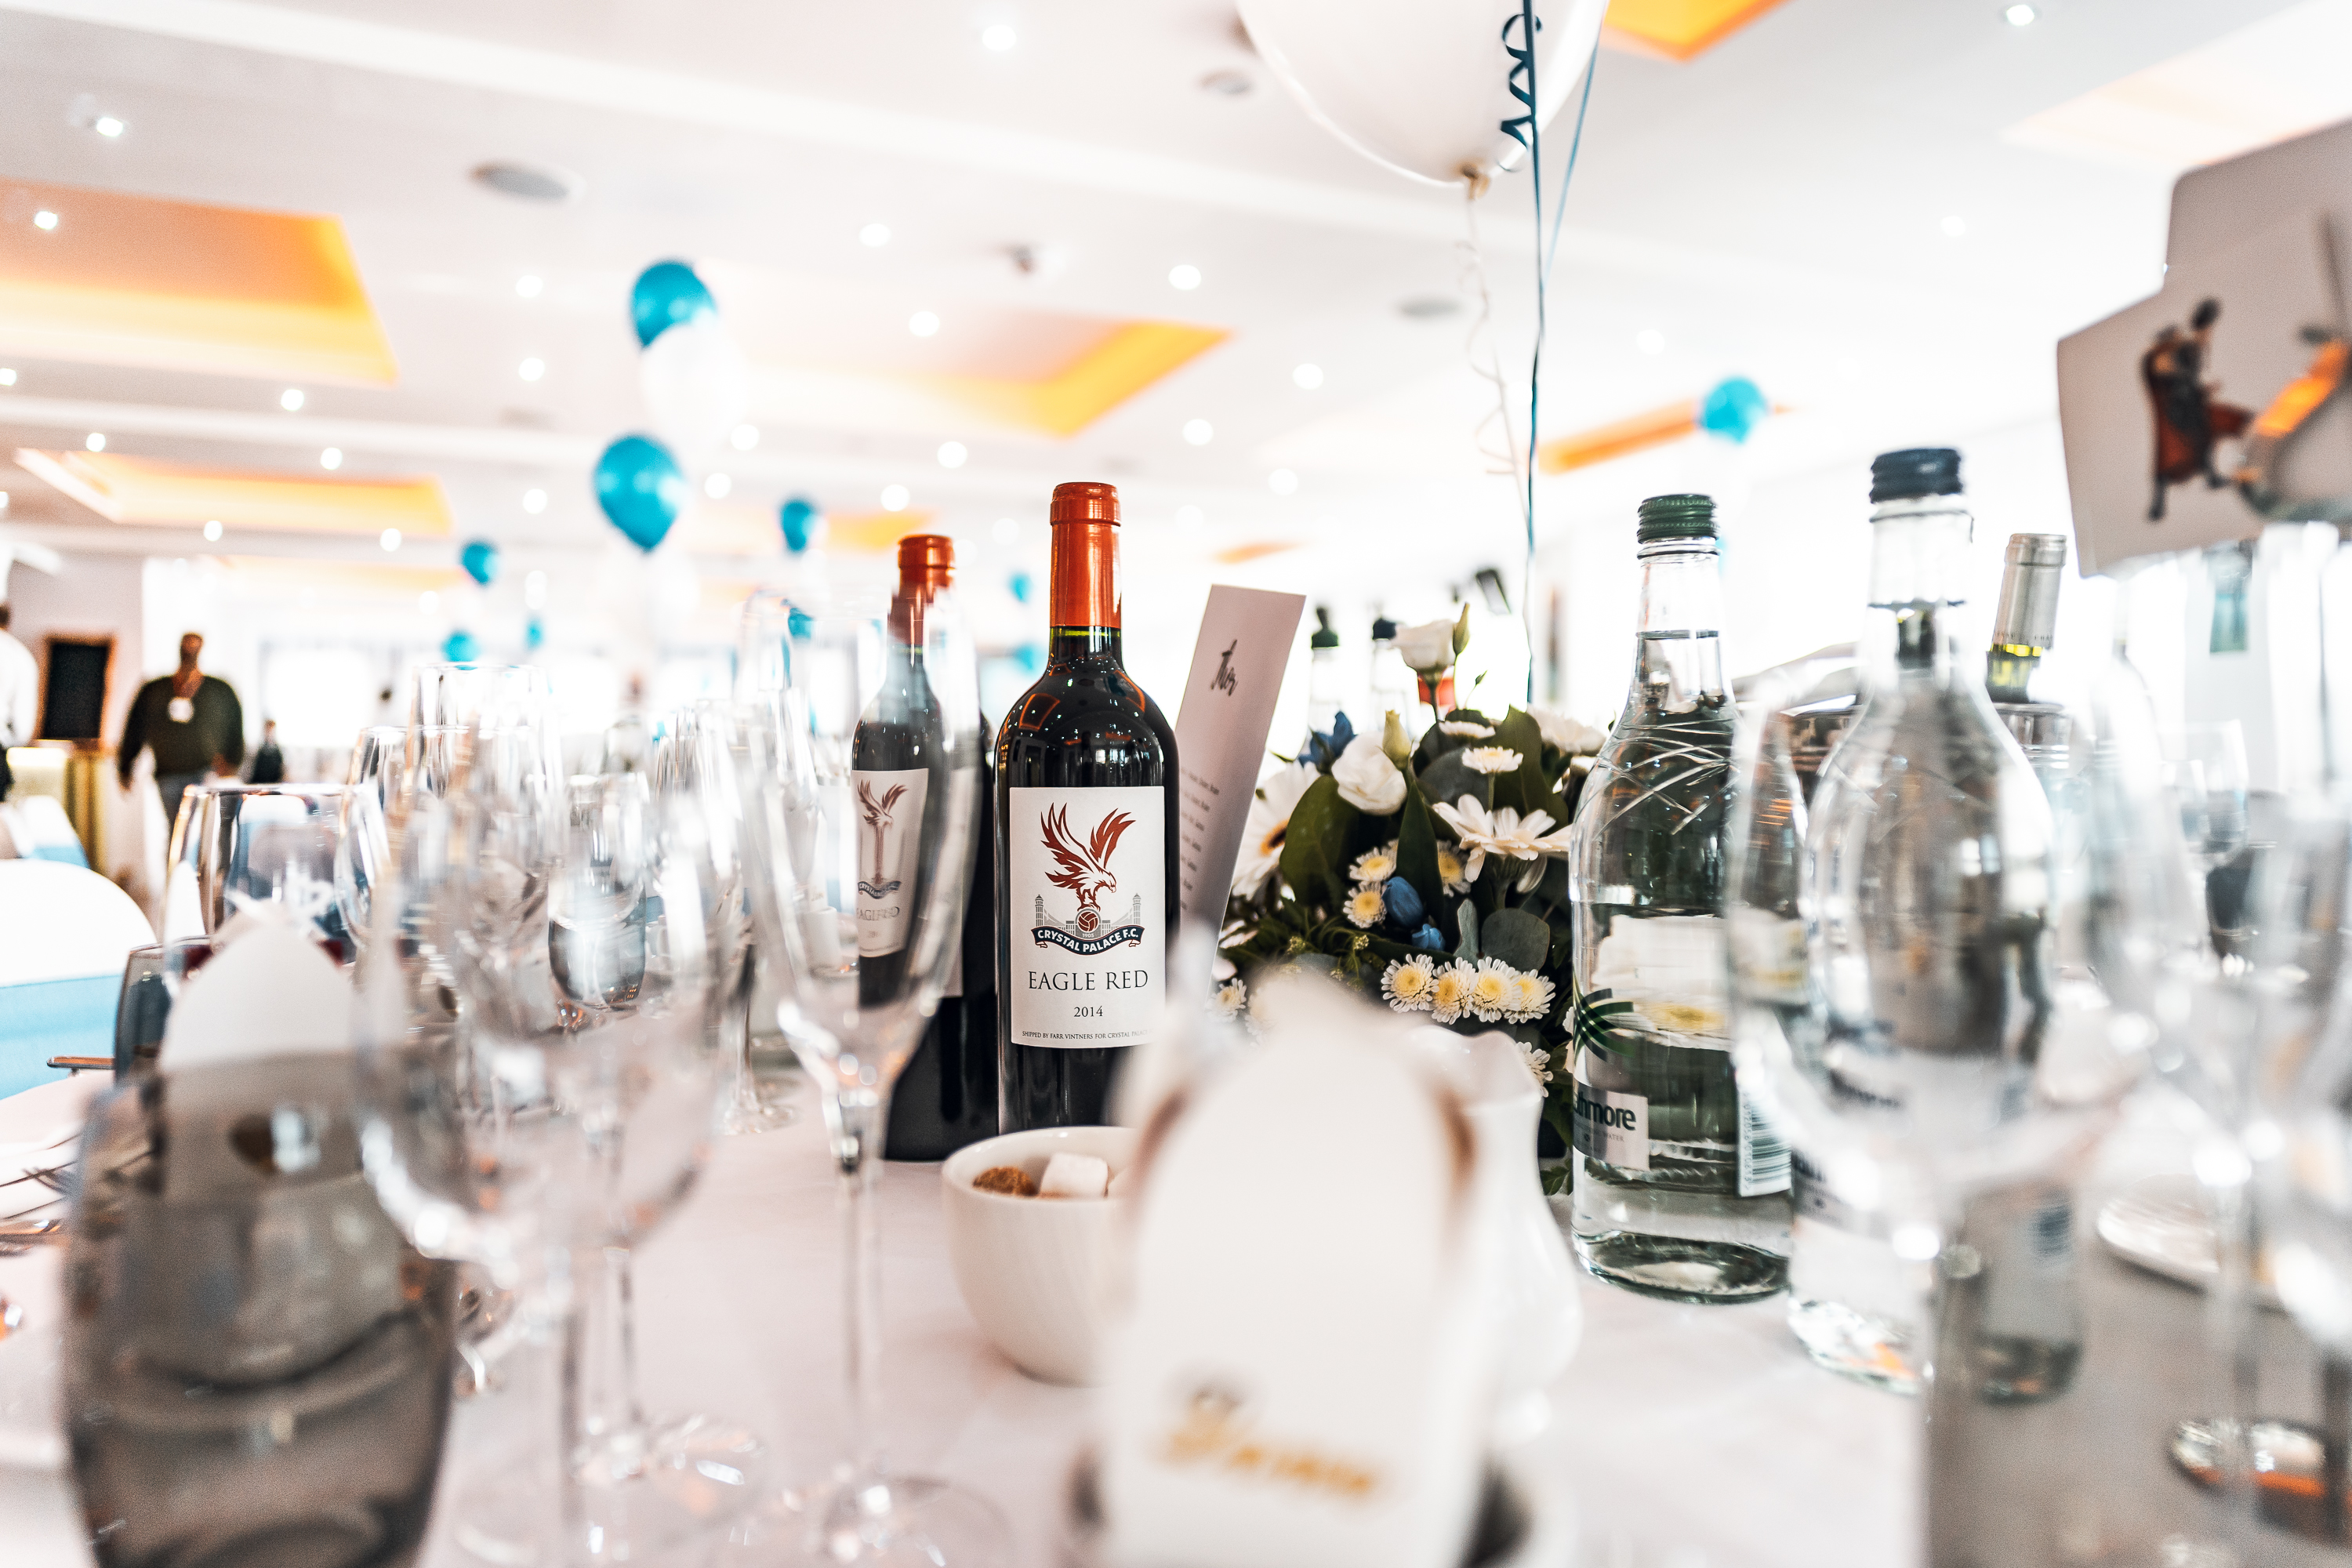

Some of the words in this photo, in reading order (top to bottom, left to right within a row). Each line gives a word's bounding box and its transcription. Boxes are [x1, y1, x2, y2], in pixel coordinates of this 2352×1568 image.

[1037, 930, 1080, 952] CRYSTAL
[1083, 932, 1123, 953] PALACE
[1123, 928, 1139, 938] F.C.
[1029, 971, 1096, 991] EAGLE
[1105, 970, 1149, 989] RED
[1073, 1005, 1103, 1018] 2014
